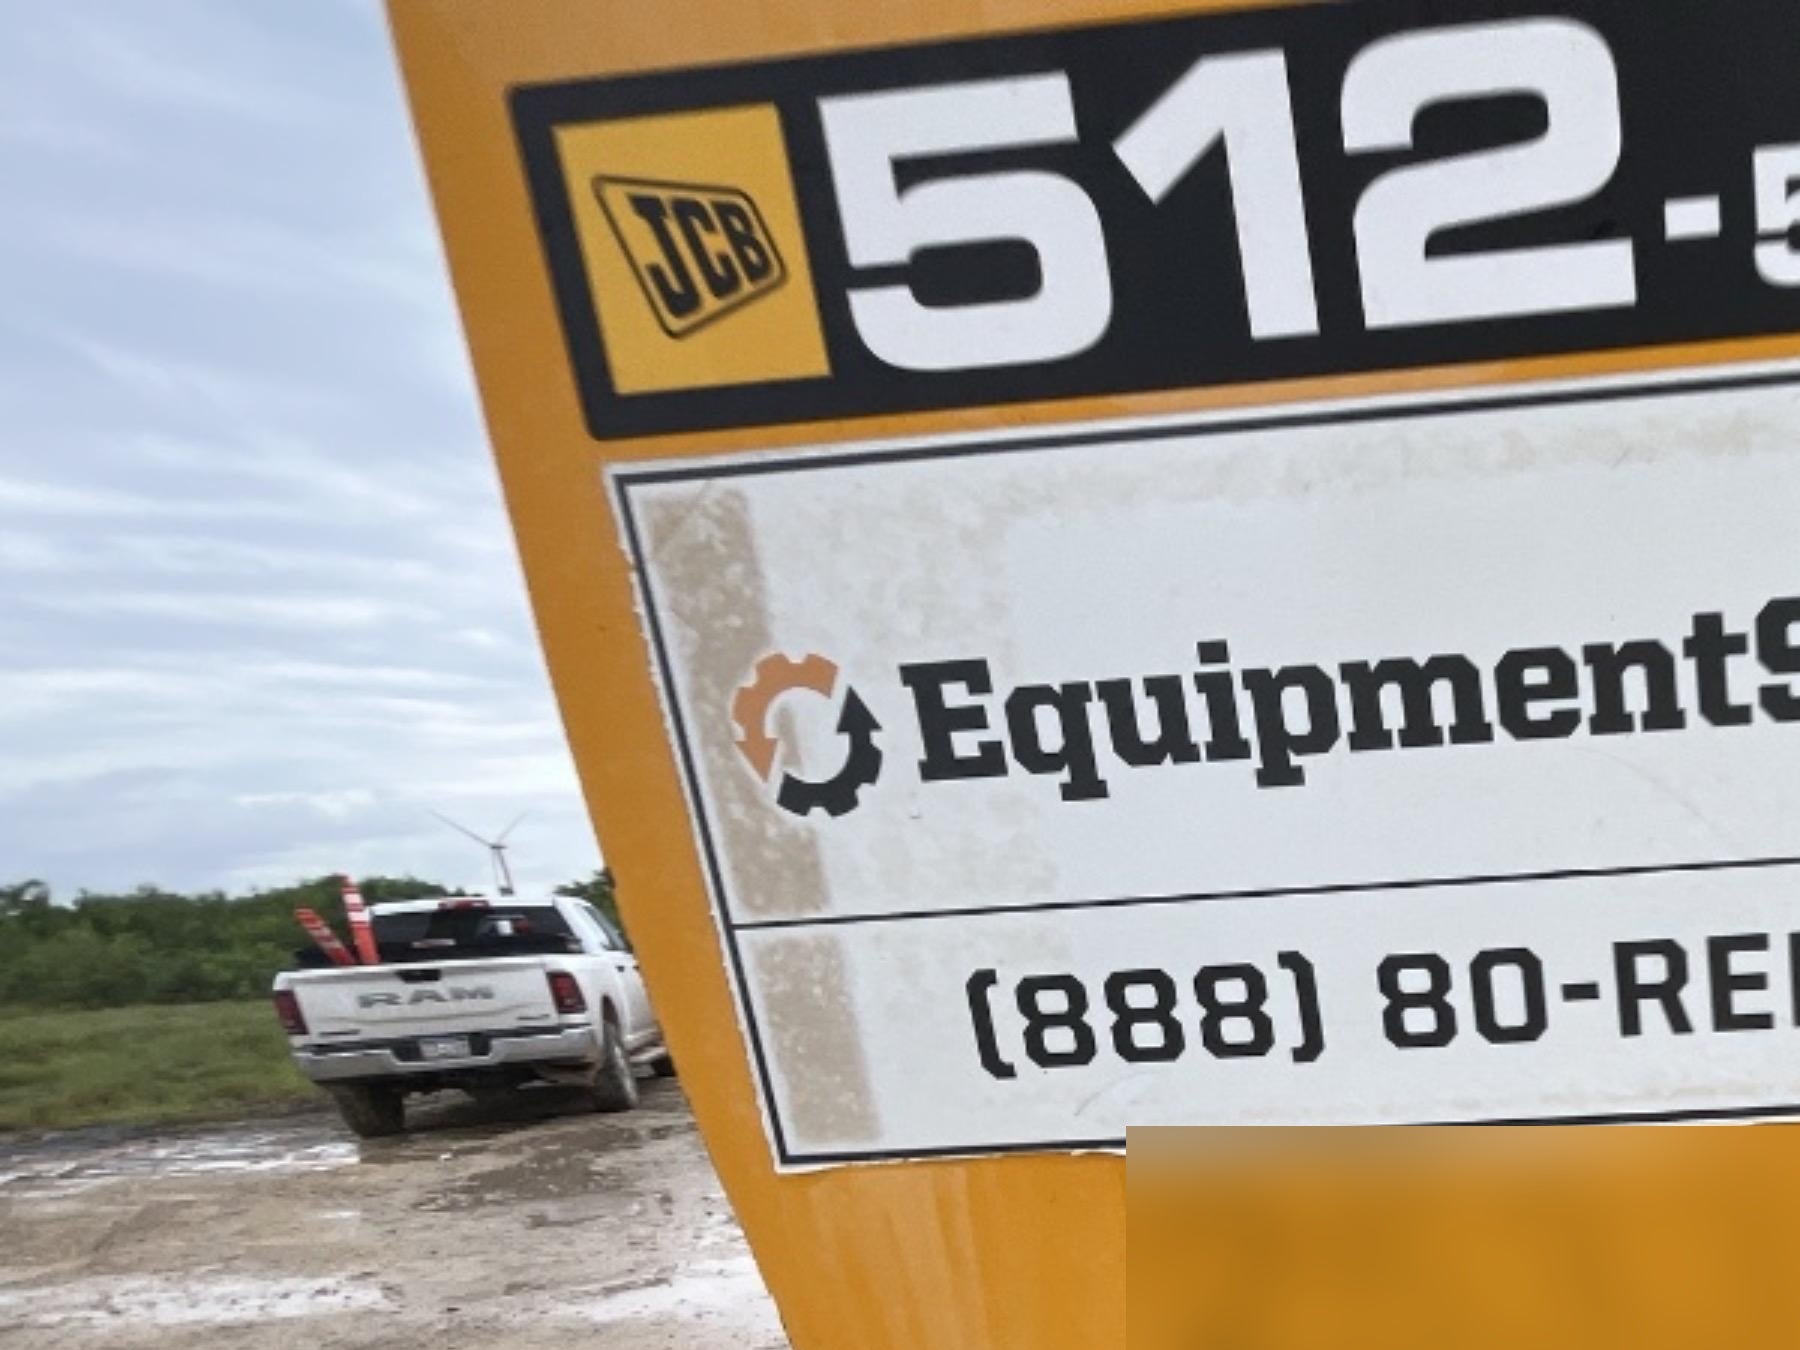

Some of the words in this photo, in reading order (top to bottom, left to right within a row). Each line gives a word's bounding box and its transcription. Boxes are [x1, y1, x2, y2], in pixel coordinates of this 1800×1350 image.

[625, 192, 774, 319] JCB
[356, 985, 495, 1009] RAM
[965, 948, 1326, 1080] (888)
